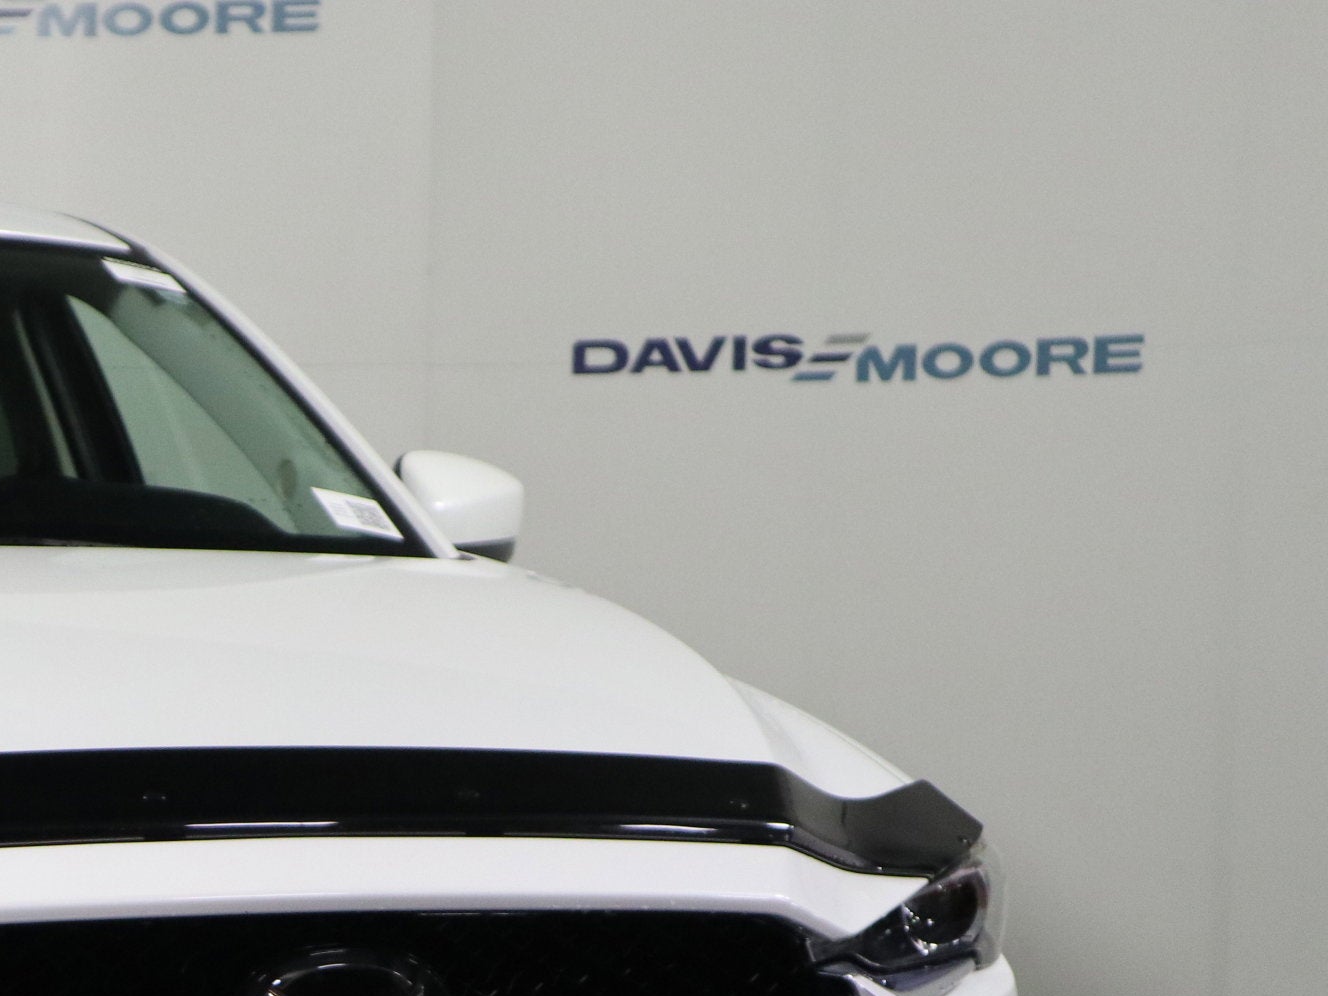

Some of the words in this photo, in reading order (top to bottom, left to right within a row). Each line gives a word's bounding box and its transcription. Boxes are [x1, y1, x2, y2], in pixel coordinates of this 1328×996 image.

[37, 0, 320, 37] MOORE
[572, 334, 804, 374] DAVIS
[855, 333, 1145, 382] MOORE
